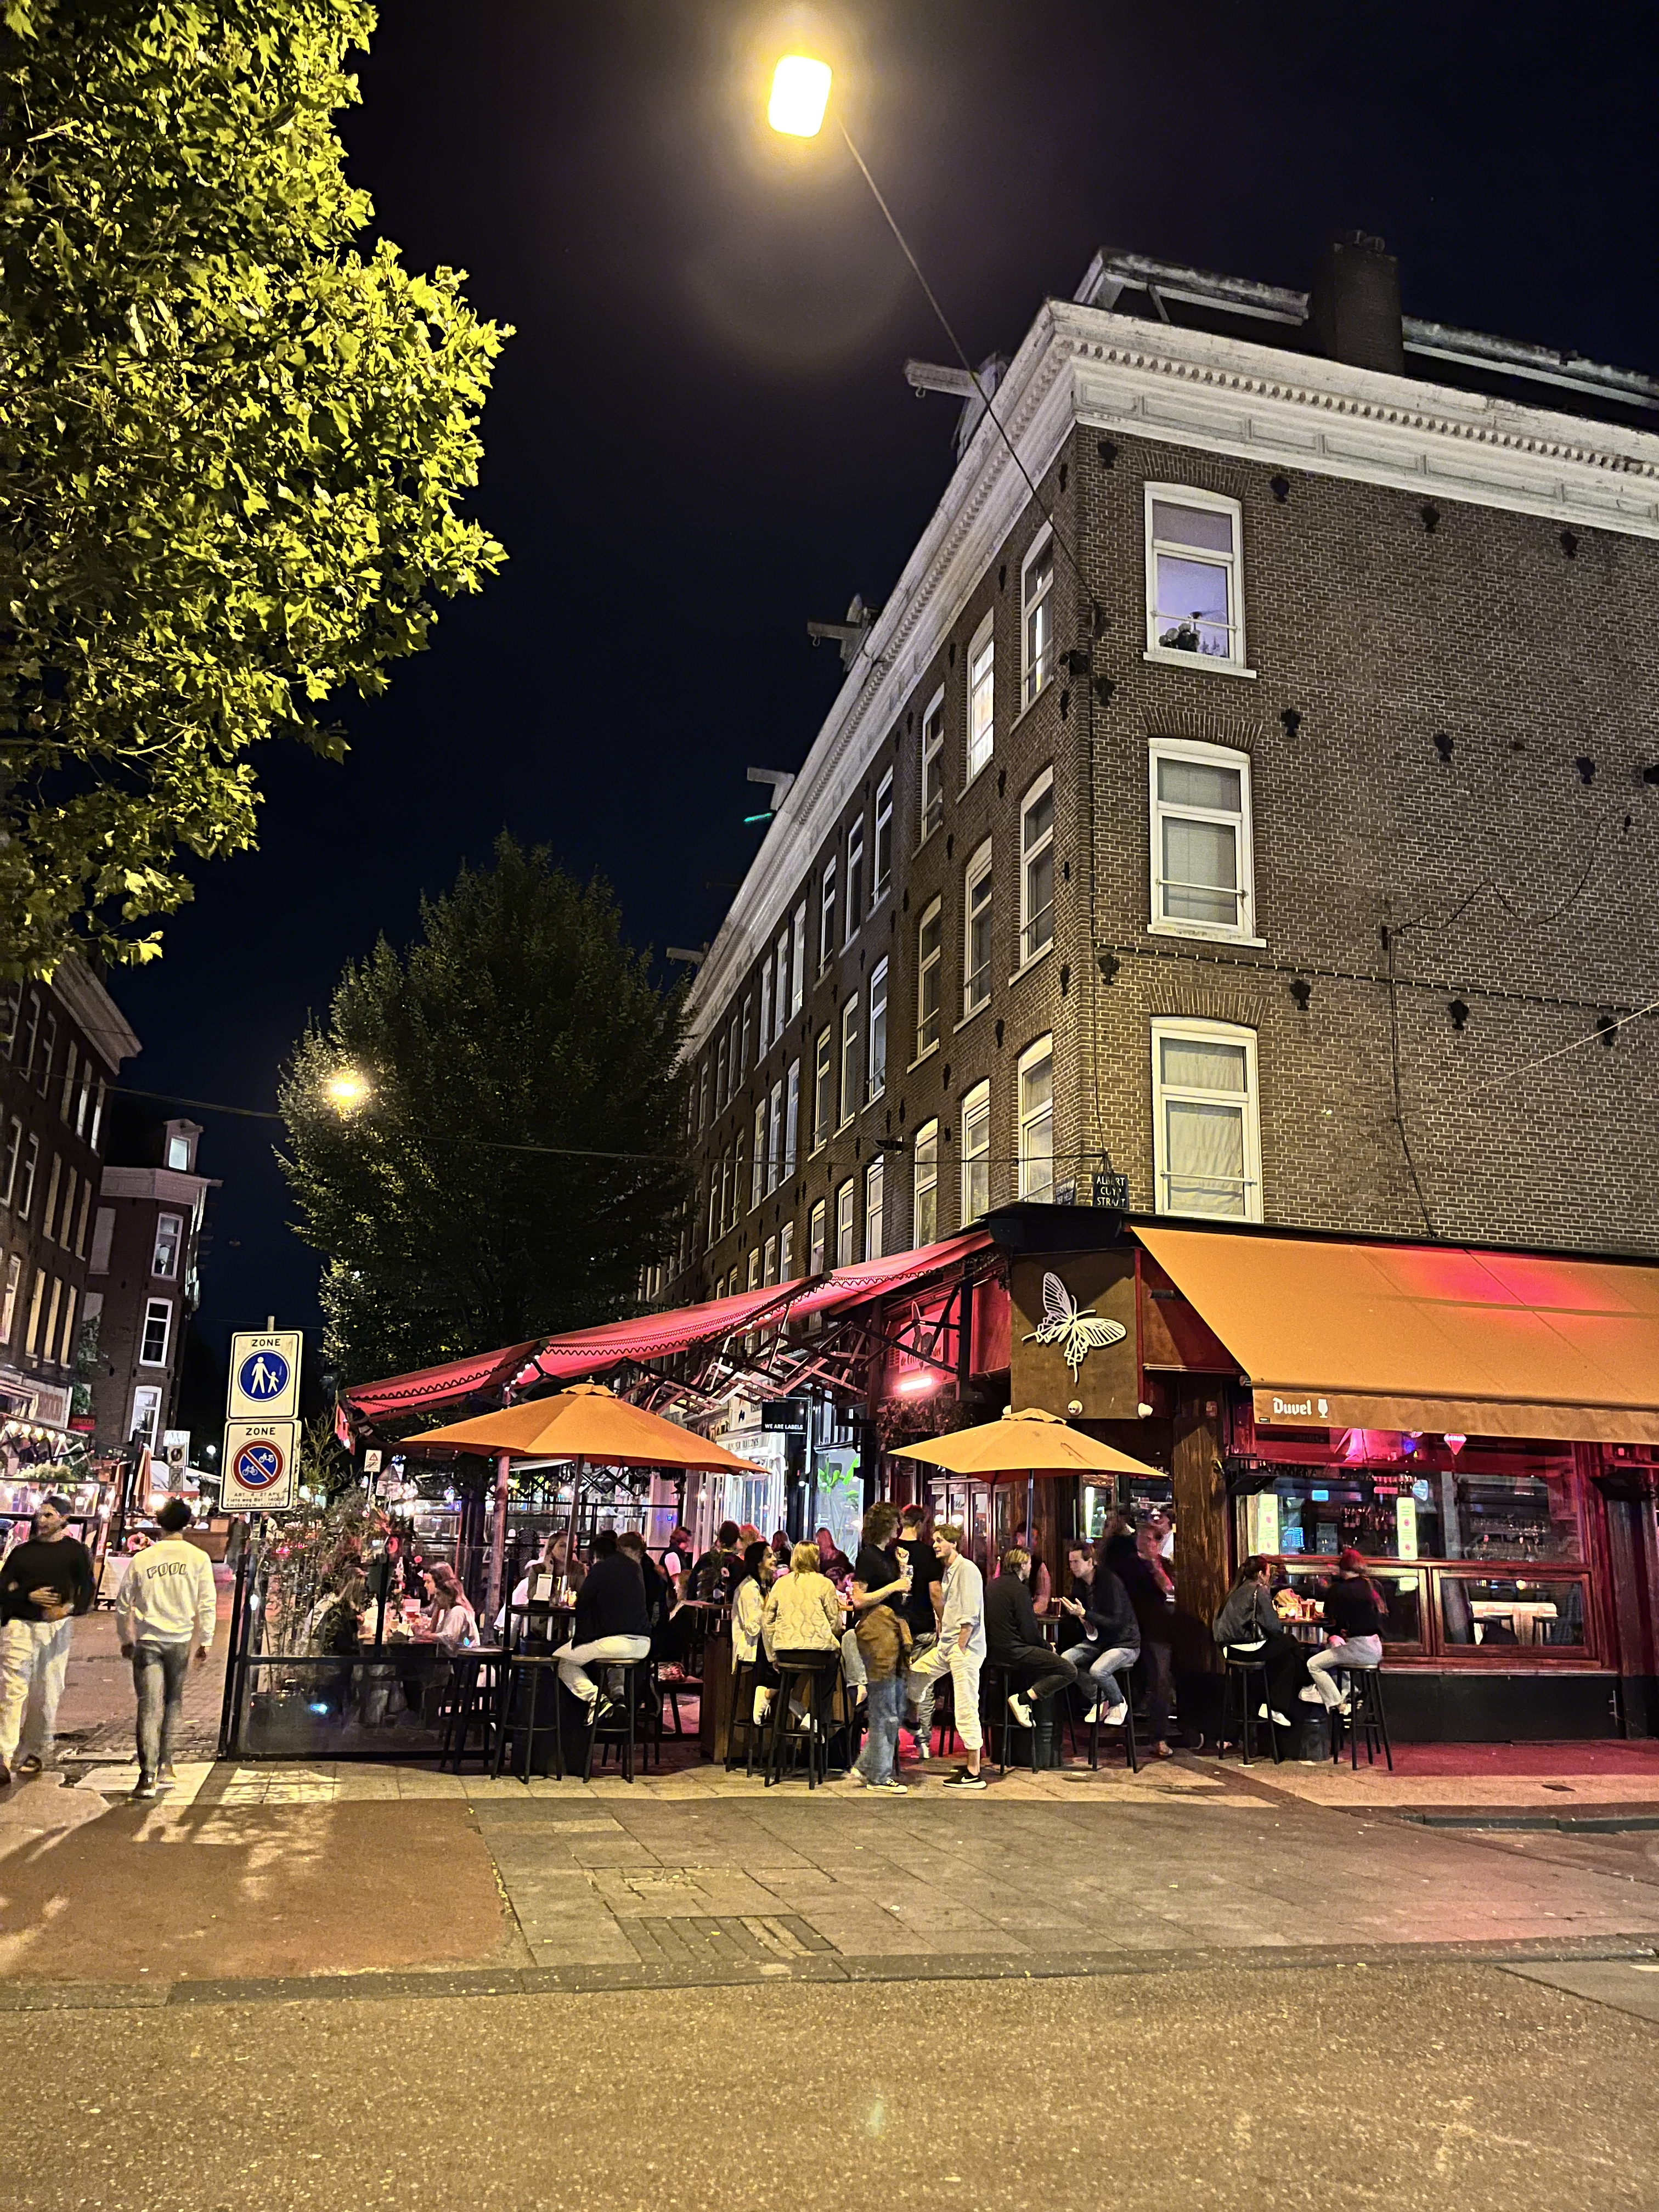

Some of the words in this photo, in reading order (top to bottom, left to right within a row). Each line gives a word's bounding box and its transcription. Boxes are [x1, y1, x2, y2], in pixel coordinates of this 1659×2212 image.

[251, 1339, 281, 1347] ZONE
[1272, 1397, 1312, 1415] Duvel
[245, 1427, 276, 1436] ZONE
[146, 1562, 187, 1579] FOOL
